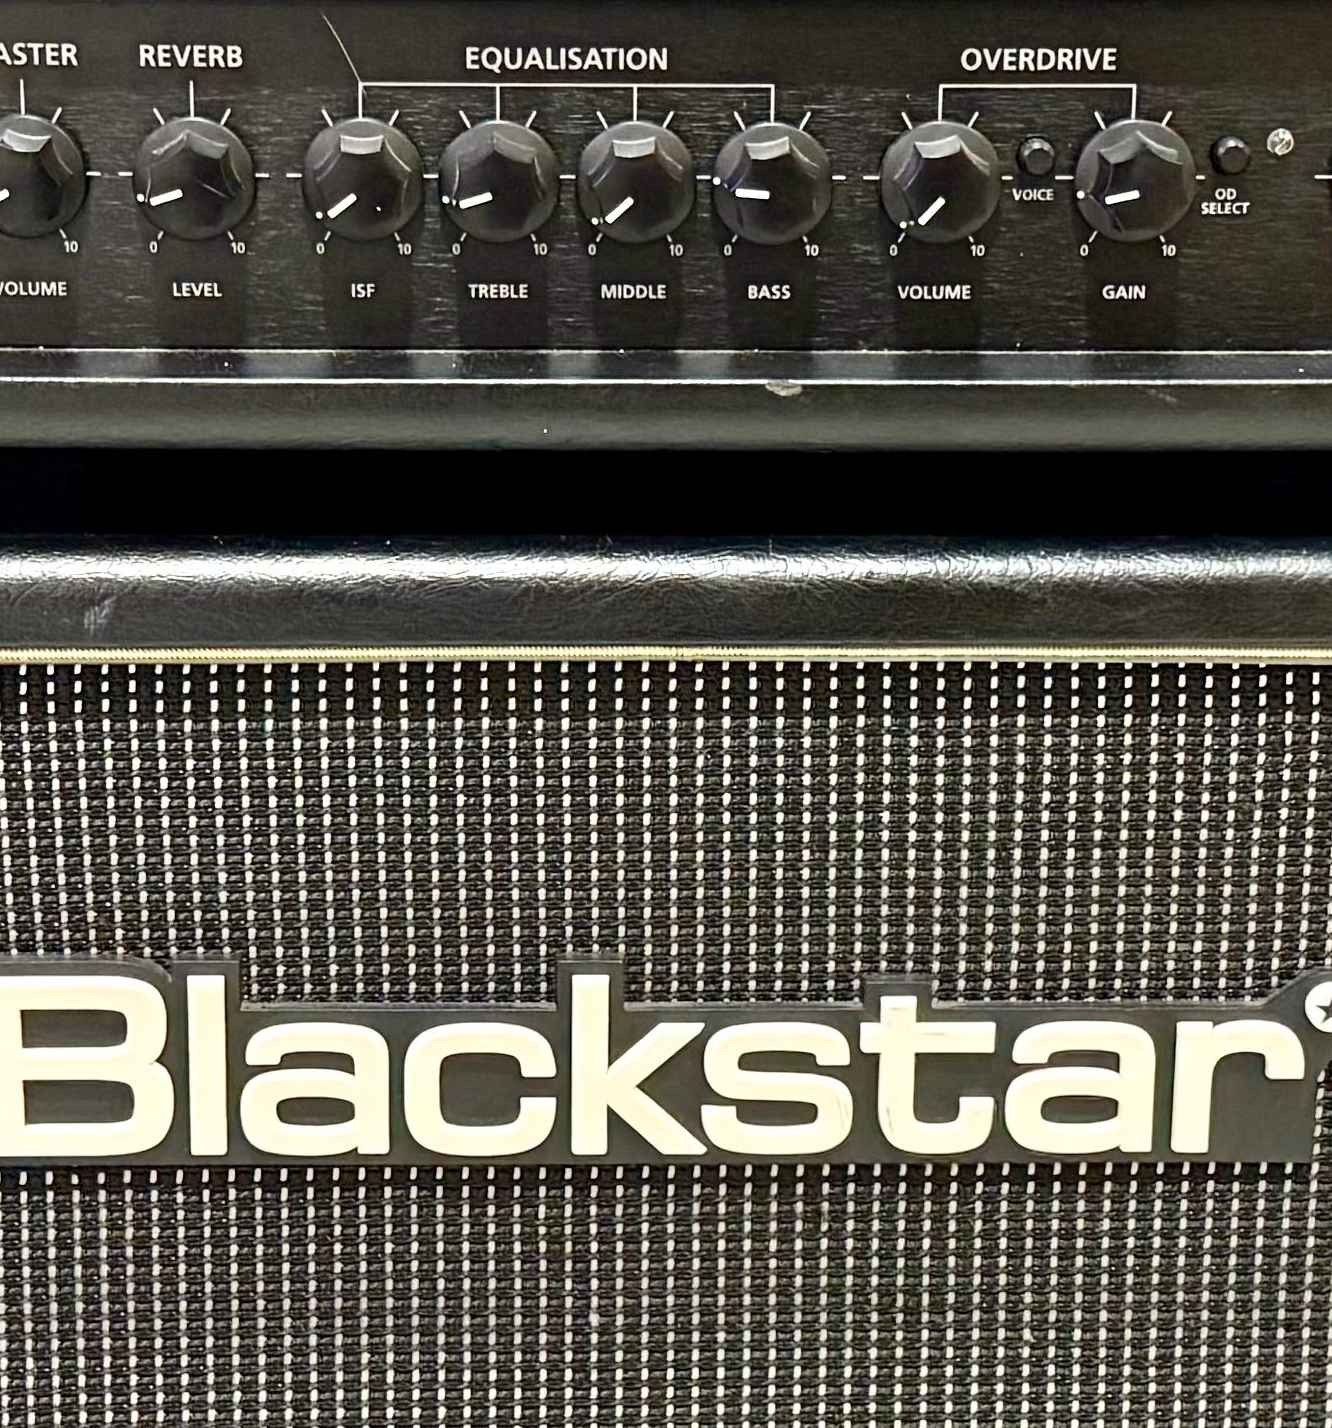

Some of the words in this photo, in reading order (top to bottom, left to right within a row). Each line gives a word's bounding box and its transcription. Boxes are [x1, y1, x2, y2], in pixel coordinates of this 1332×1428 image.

[139, 44, 243, 68] REVERB
[465, 46, 668, 74] EQUALISATION
[960, 47, 1117, 72] OVERDRIVE
[1012, 187, 1054, 201] VOICE
[1215, 188, 1236, 201] OD
[1201, 202, 1250, 215] SELECT
[64, 240, 79, 253] 10
[149, 241, 158, 255] 0
[231, 242, 246, 255] 10
[316, 243, 325, 255] 0
[397, 243, 412, 256] 10
[452, 243, 461, 256] 0
[534, 243, 548, 256] 10
[588, 243, 597, 256] 0
[669, 243, 683, 257] 10
[723, 243, 732, 256] 0
[804, 243, 820, 257] 10
[889, 245, 898, 257] 0
[971, 245, 985, 257] 10
[1079, 244, 1088, 257] 0
[1161, 244, 1176, 257] 10
[172, 282, 223, 298] LEVEL
[351, 283, 375, 298] ISF
[467, 283, 529, 299] TREBLE
[600, 283, 667, 300] MIDDLE
[747, 284, 791, 300] BASS
[897, 284, 971, 300] VOLUME
[1102, 284, 1146, 300] GAIN
